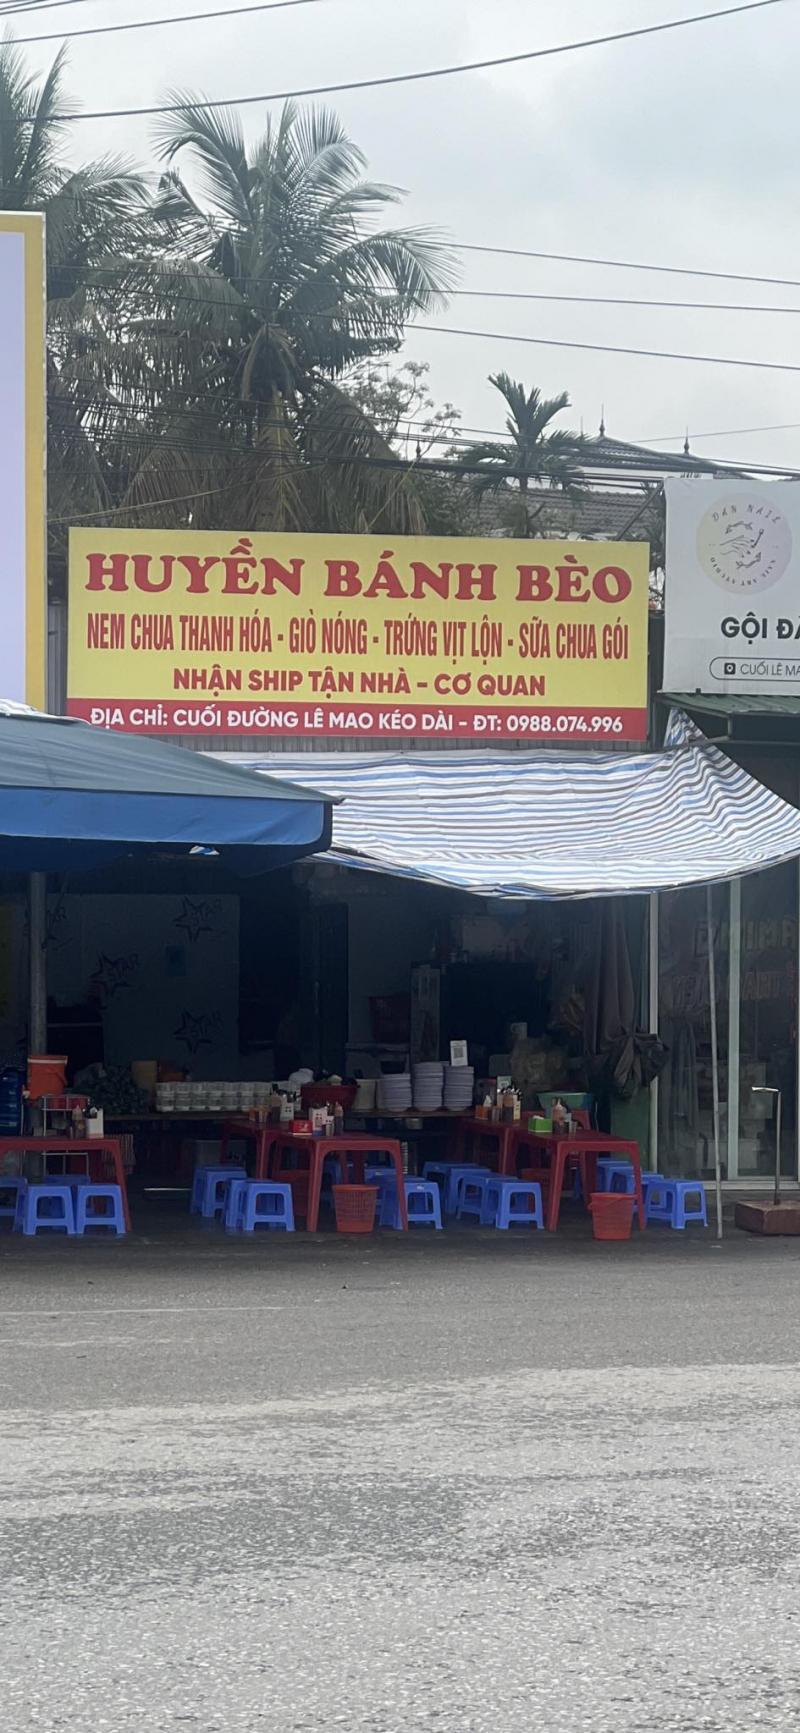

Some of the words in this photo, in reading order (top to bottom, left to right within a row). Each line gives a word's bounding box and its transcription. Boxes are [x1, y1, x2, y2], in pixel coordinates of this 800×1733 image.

[85, 537, 305, 596] HUYỀN
[324, 550, 498, 600] BÁNH
[515, 554, 632, 603] BÈO
[87, 612, 125, 649] NEM
[130, 614, 174, 650] CHUA
[179, 615, 234, 651] THANH
[239, 608, 272, 652] HÓA
[289, 608, 316, 653] GIÒ
[322, 611, 368, 655] NÓNG
[383, 613, 437, 656] TRỨNG
[443, 620, 467, 665] VỊT
[471, 615, 502, 665] LỘN
[519, 616, 551, 658] SỮA
[556, 622, 597, 659] CHUA
[602, 618, 629, 659] GÓI
[721, 611, 768, 645] GỘI
[173, 664, 242, 697] NHẬN
[248, 669, 303, 692] SHIP
[308, 666, 354, 699] TẬN
[360, 667, 411, 694] NHÀ
[434, 673, 471, 695] CƠ
[477, 675, 546, 696] QUAN
[740, 660, 769, 675] CUỐI
[771, 662, 783, 676] LÊ
[90, 707, 125, 729] ĐỊA
[129, 704, 168, 725] CHỈ:
[173, 704, 221, 727] CUỐI
[227, 706, 298, 728] ĐƯỜNG
[304, 708, 324, 728] LÊ
[329, 711, 374, 730] MAO
[379, 709, 419, 730] KÉO
[422, 710, 454, 730] DÀI
[473, 715, 502, 731] ĐT:
[507, 715, 623, 732] 0988.074.996
